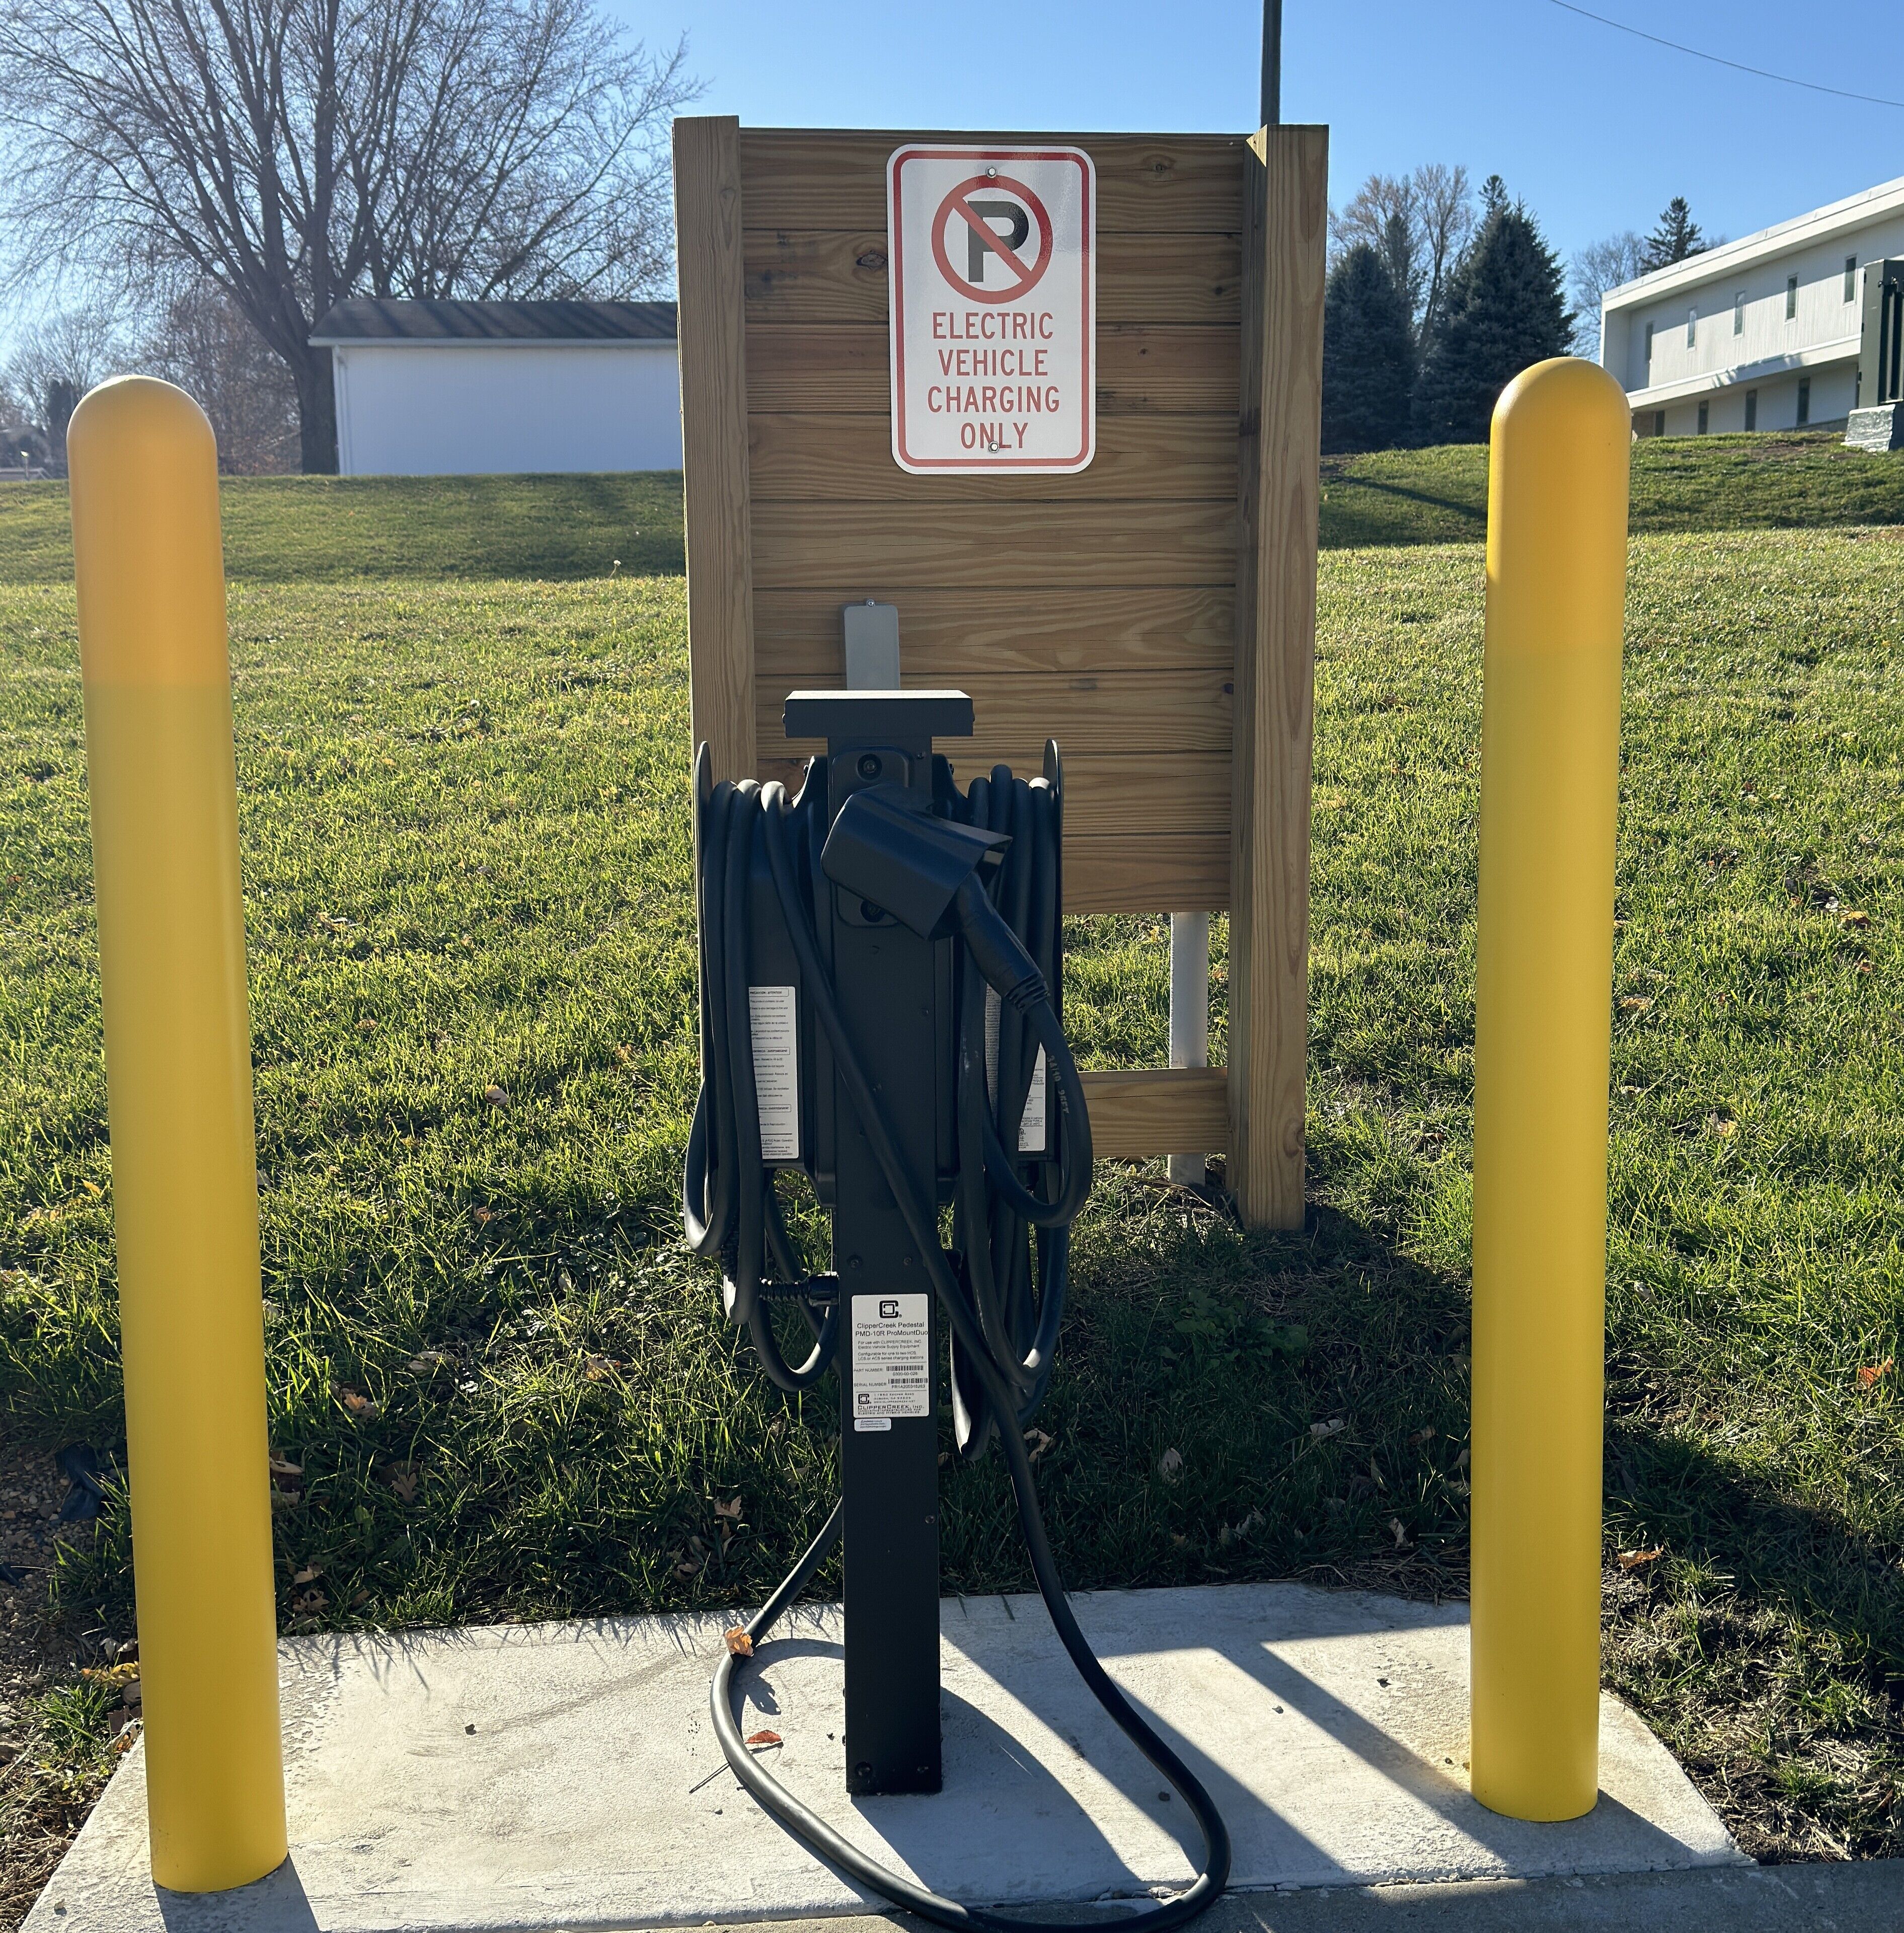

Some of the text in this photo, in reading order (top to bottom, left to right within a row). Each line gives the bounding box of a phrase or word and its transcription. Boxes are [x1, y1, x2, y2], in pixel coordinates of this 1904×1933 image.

[932, 312, 1053, 339] ELECTRIC
[938, 349, 1048, 377] VEHICLE
[928, 386, 1060, 413] CHARGING
[960, 422, 1028, 449] ONLY
